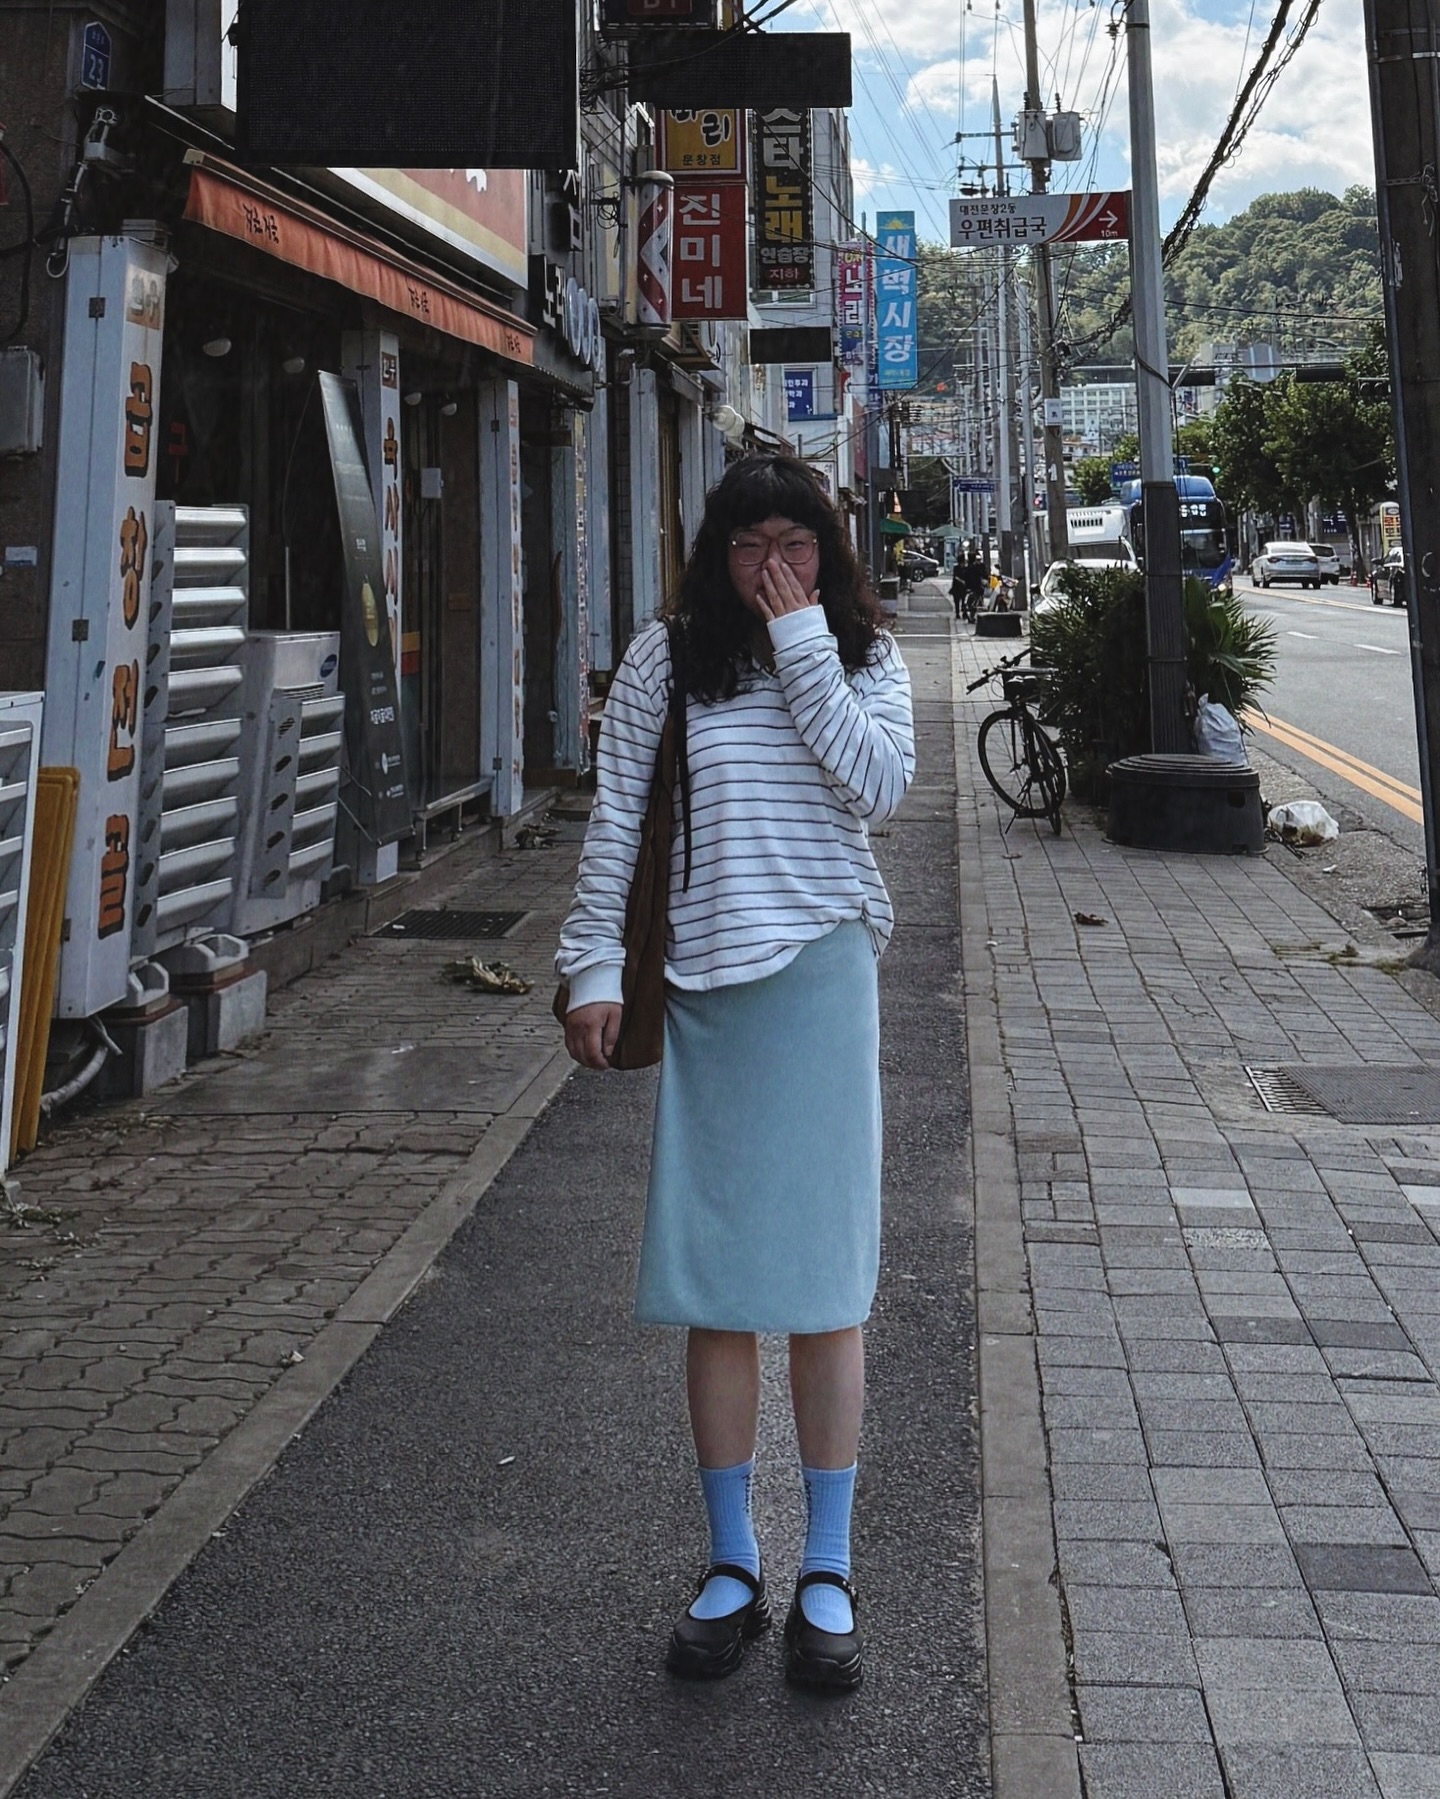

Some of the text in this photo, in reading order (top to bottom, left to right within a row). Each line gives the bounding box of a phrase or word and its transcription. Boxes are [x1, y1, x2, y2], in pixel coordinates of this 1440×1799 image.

[89, 53, 104, 84] 23
[682, 154, 721, 166] 문창점
[764, 175, 803, 243] 노래
[959, 203, 1017, 215] 대전문창2동
[958, 216, 1047, 240] 우편취급국
[1101, 229, 1118, 237] 10m
[679, 193, 723, 309] 진미네
[760, 247, 810, 264] 연습장
[769, 267, 801, 279] 지하
[881, 235, 914, 363] 새벽시장
[98, 361, 153, 940] 곱창전골
